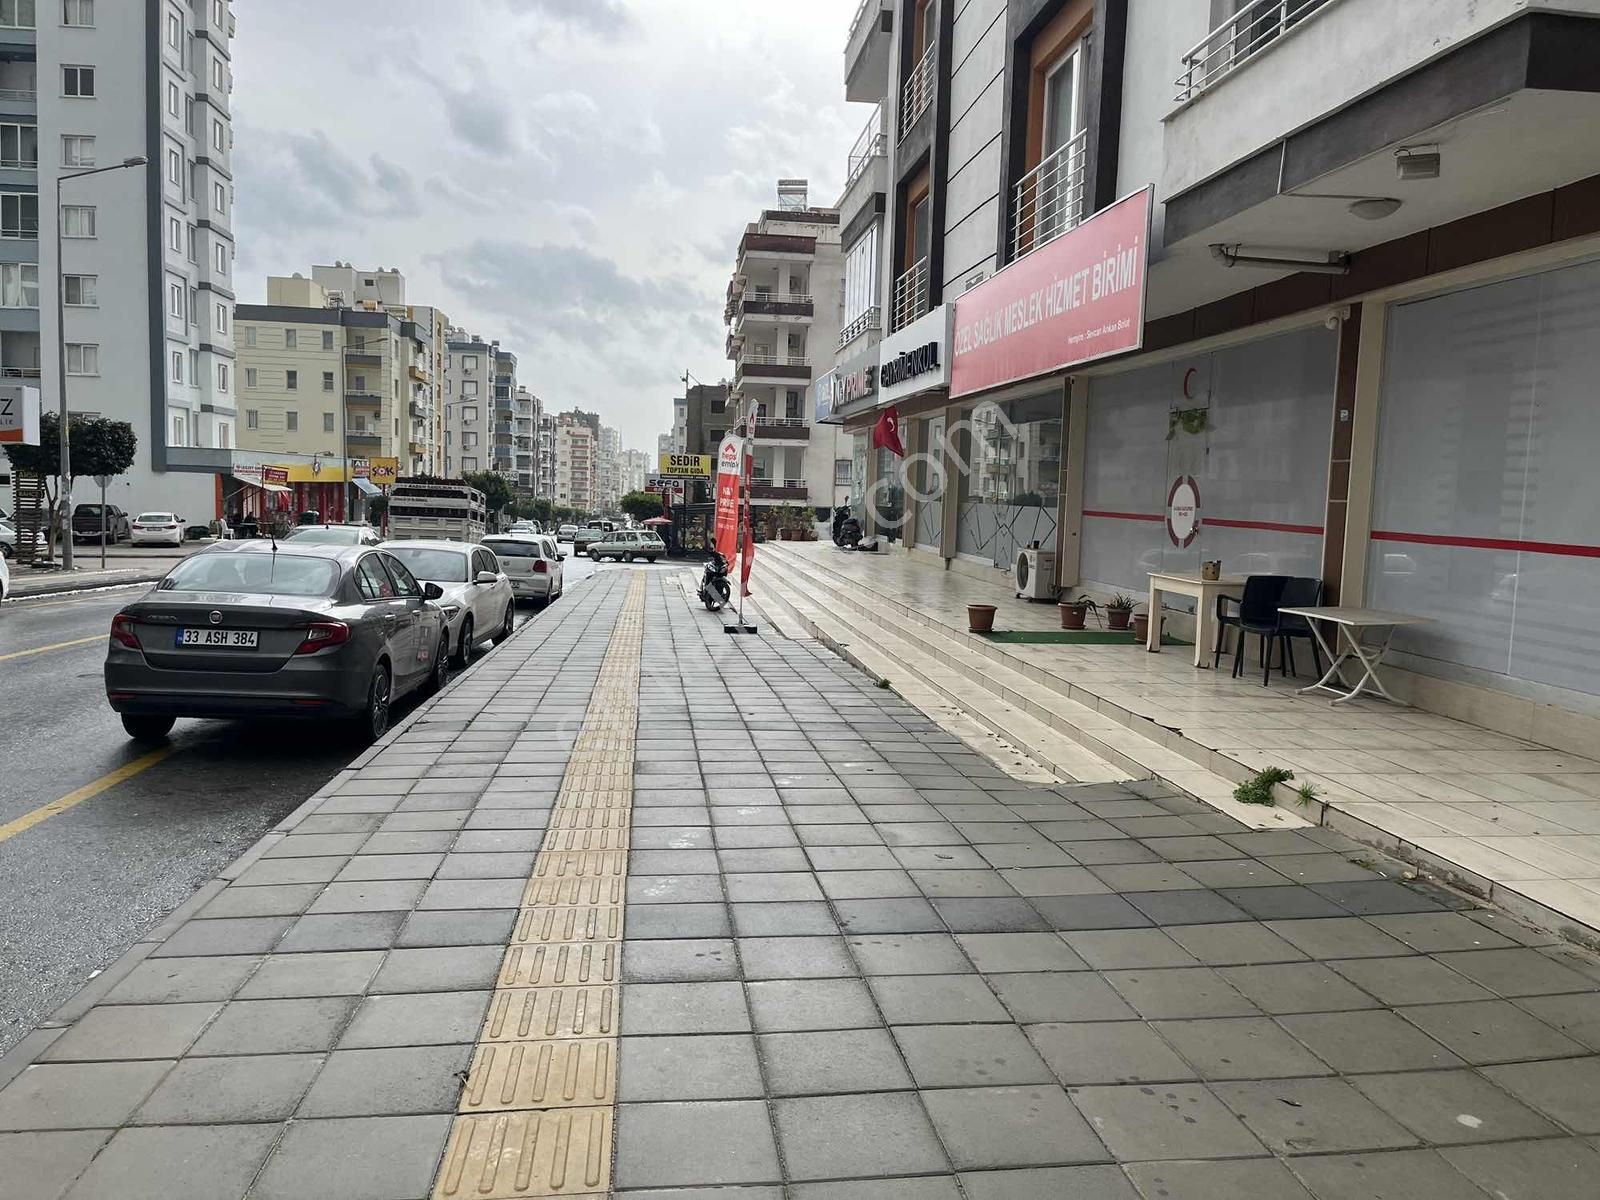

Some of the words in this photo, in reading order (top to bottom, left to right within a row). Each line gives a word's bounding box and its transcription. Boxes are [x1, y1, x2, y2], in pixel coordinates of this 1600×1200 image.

[954, 326, 973, 357] ÖZEL
[973, 310, 1002, 349] SAĞLIK
[1005, 290, 1043, 336] MESLEK
[1045, 268, 1089, 317] HİZMET
[1092, 235, 1138, 301] BİRİMİ
[185, 630, 200, 643] 33
[205, 631, 229, 644] ASH
[233, 632, 255, 645] 384
